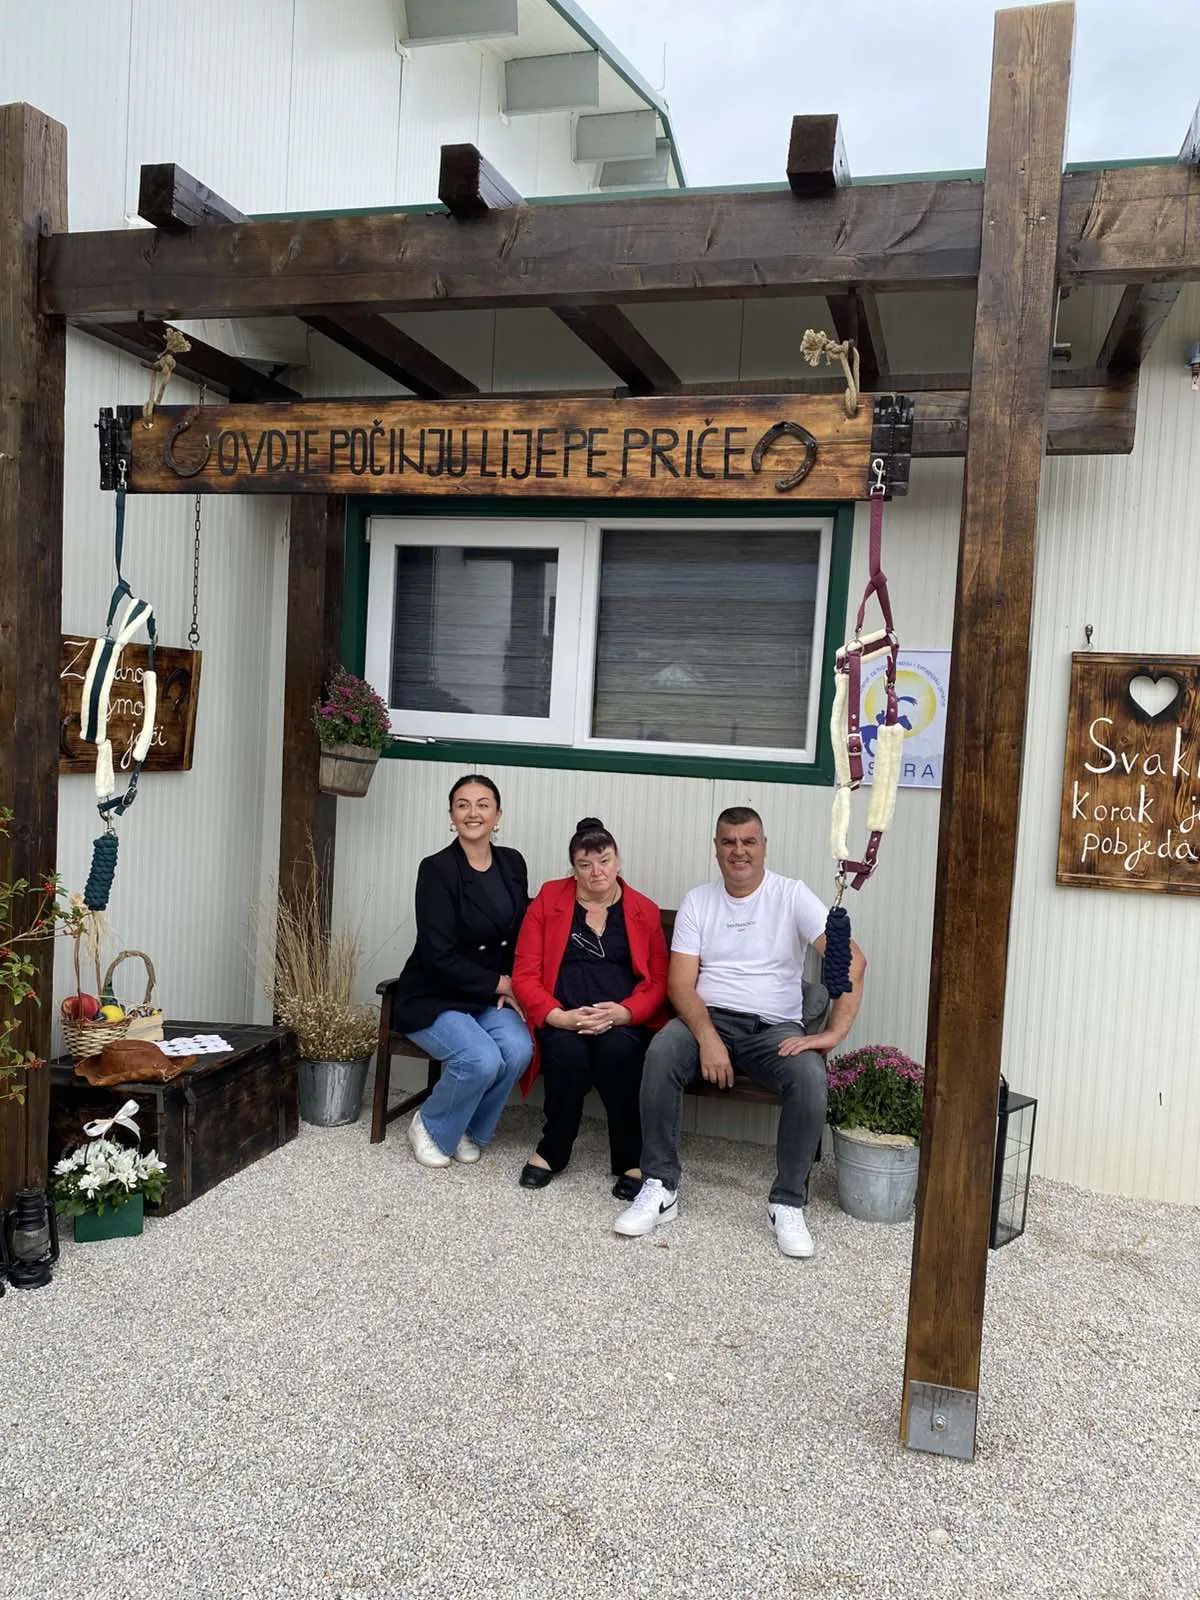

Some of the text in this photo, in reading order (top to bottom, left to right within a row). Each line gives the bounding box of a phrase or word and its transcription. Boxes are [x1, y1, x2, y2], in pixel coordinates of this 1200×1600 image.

[217, 417, 748, 480] OVDJE POČINJU LIJEPE PRIČE
[1080, 828, 1199, 872] pobjeda
